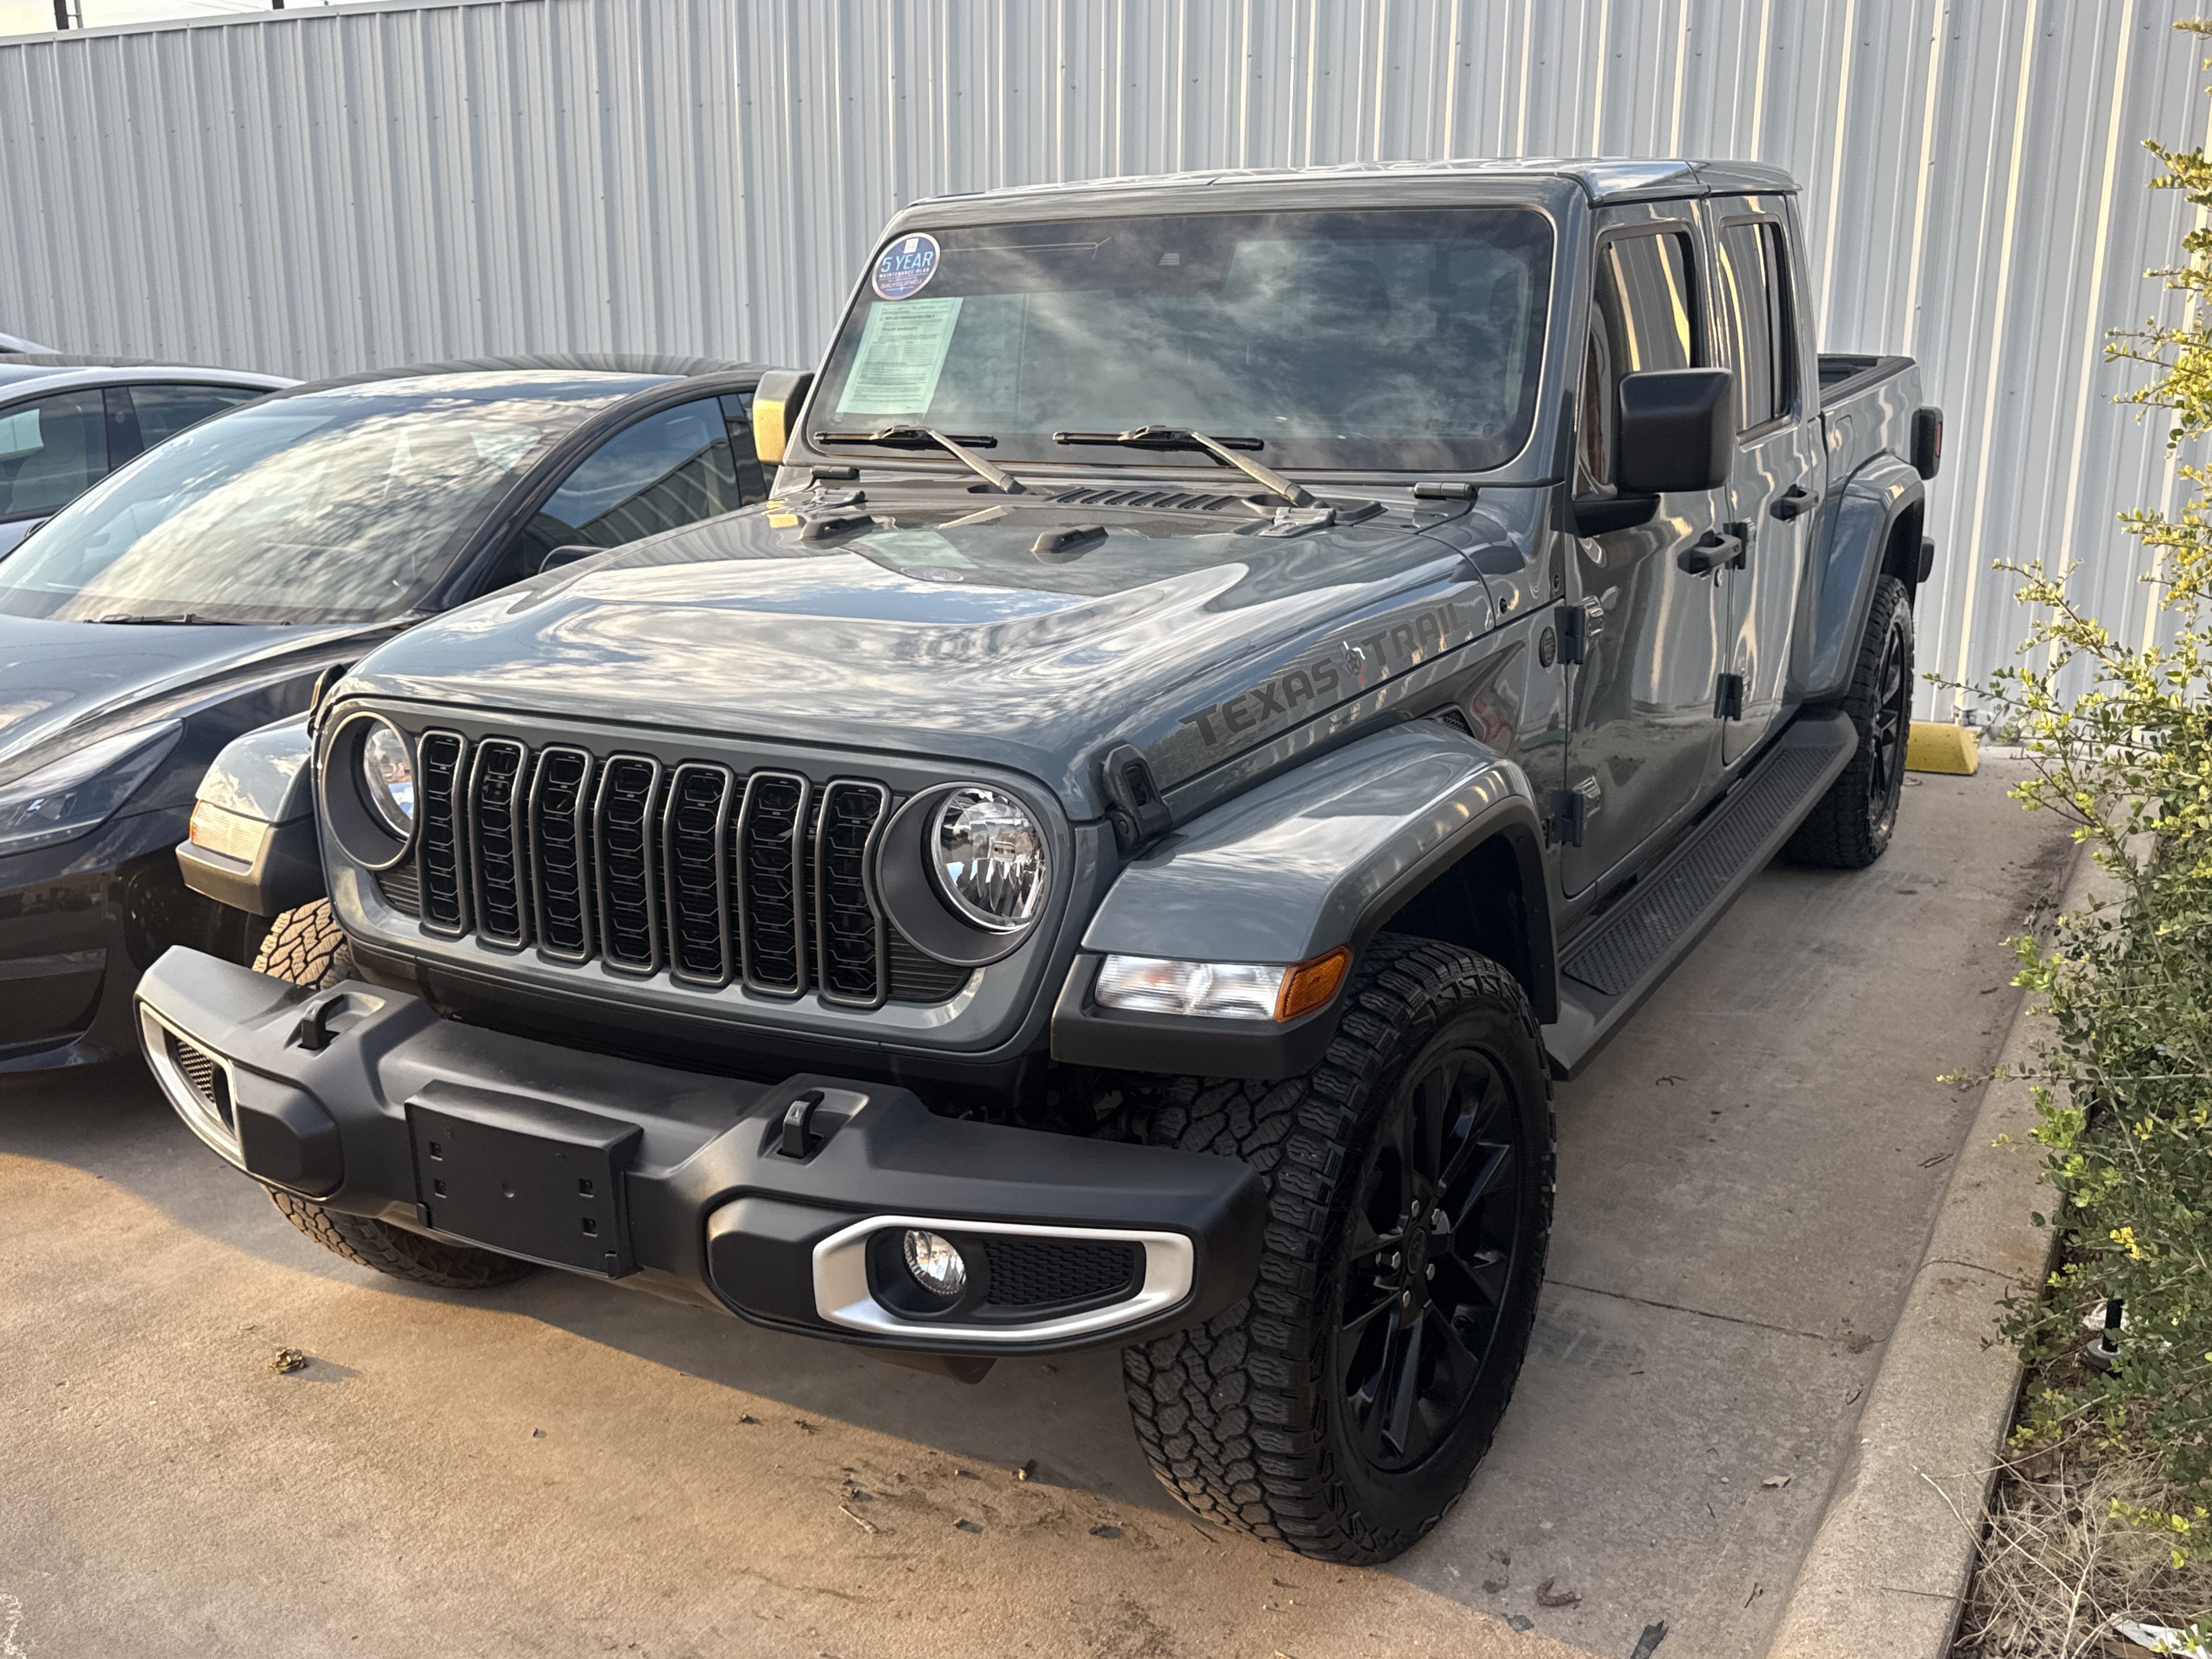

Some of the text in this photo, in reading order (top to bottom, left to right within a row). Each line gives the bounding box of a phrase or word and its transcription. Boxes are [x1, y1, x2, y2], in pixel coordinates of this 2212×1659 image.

[881, 251, 934, 272] 5 YEAR
[1180, 658, 1339, 747] TEXAS
[1364, 602, 1469, 666] TRAIL
